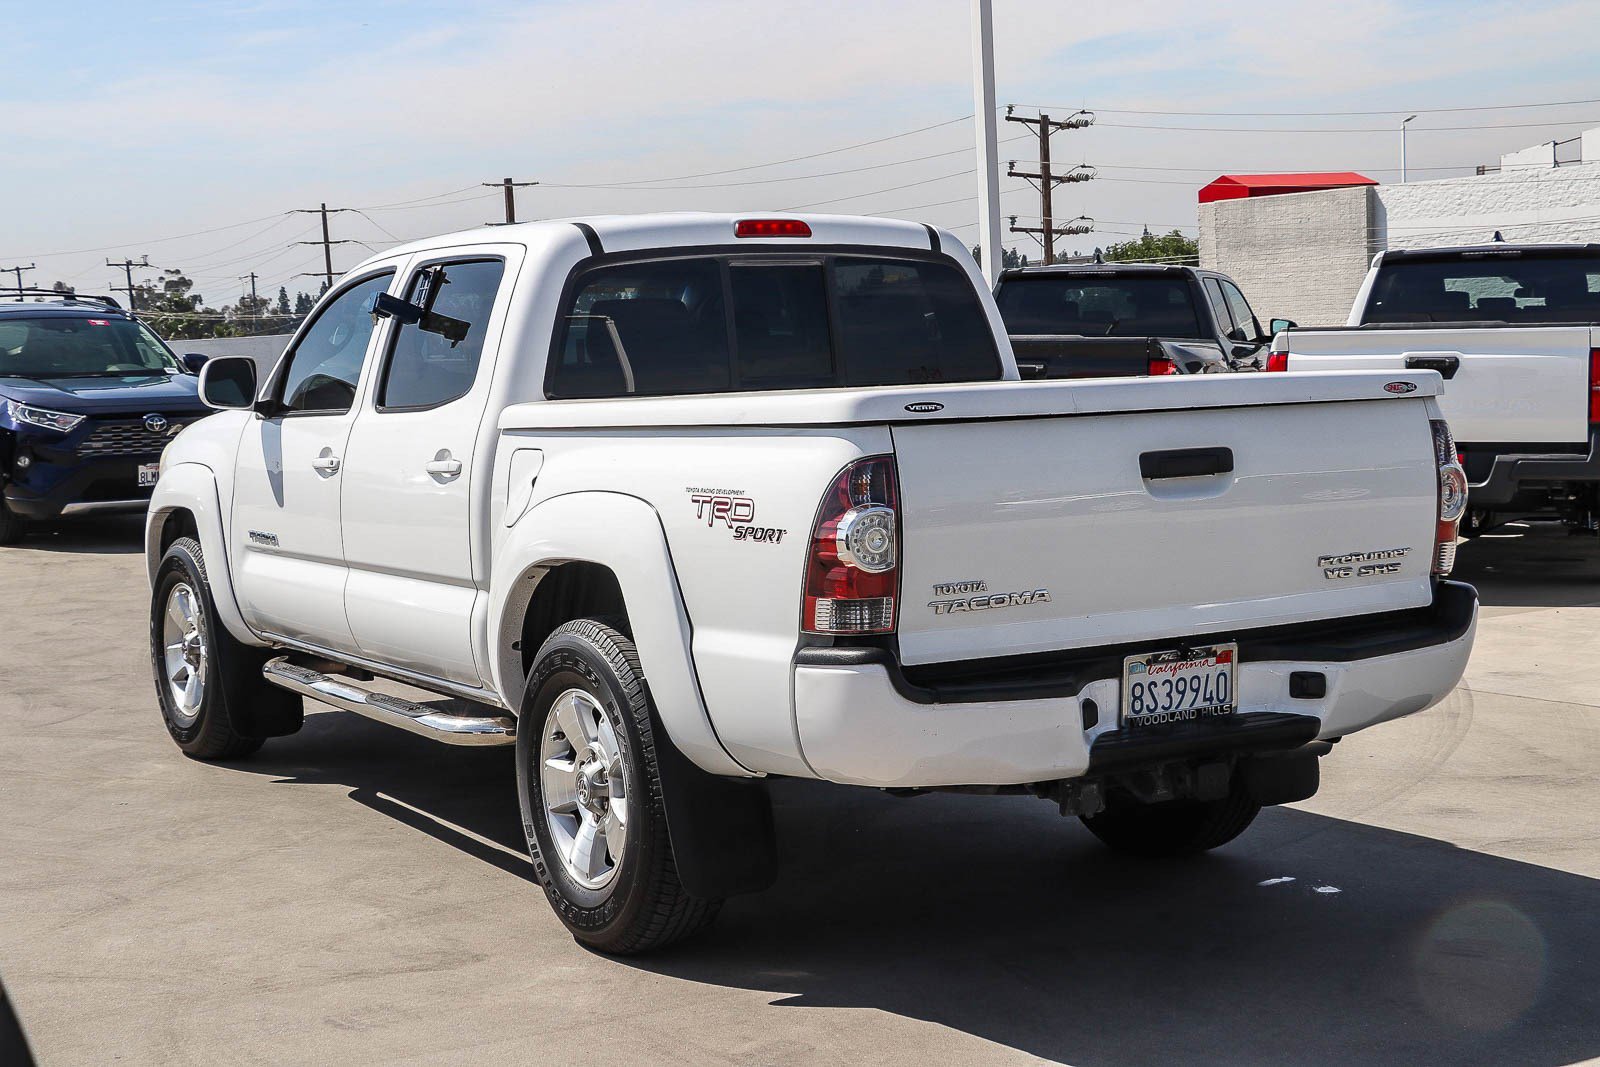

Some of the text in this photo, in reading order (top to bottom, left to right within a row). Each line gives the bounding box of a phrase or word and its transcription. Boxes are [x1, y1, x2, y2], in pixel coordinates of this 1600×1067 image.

[691, 494, 755, 529] TRD
[733, 525, 785, 544] SPORT
[1324, 562, 1402, 580] V6 SR5
[933, 580, 988, 596] TOYOTA
[927, 588, 1053, 615] TACOMA
[1147, 658, 1215, 677] California
[1130, 671, 1228, 715] 8S39940
[1201, 704, 1231, 718] HILLS
